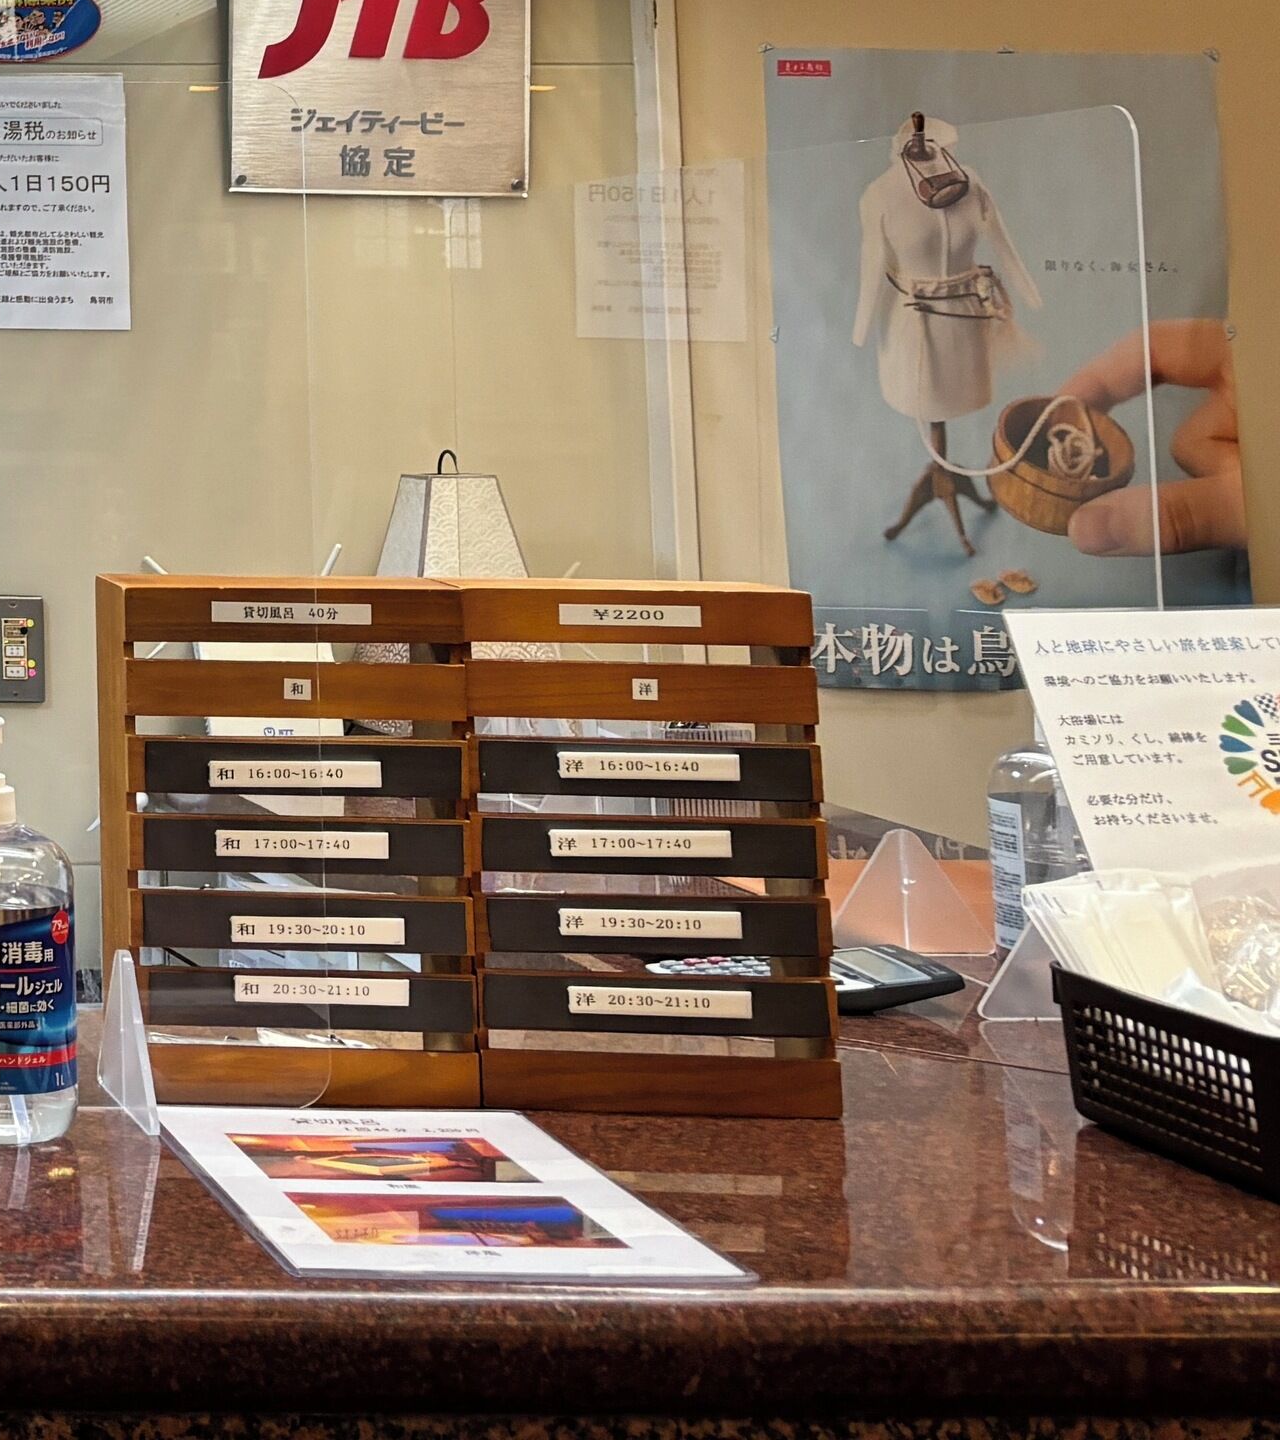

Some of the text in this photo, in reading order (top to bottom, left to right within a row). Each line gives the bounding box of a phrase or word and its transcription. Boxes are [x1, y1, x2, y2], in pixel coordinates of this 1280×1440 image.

[290, 107, 466, 135] ジェイティービー
[339, 144, 416, 178] 協定
[243, 605, 339, 621] 貸切風呂 40分
[592, 608, 665, 621] ¥2200
[289, 682, 304, 696] 和
[638, 682, 653, 697] 洋
[1058, 713, 1125, 727] 大浴場には
[564, 758, 585, 773] 洋
[216, 767, 235, 781] 和
[221, 837, 241, 851] 和
[557, 836, 577, 851] 洋
[236, 922, 256, 936] 和
[565, 914, 585, 930] 洋
[241, 981, 260, 996] 和
[575, 991, 596, 1007] 洋
